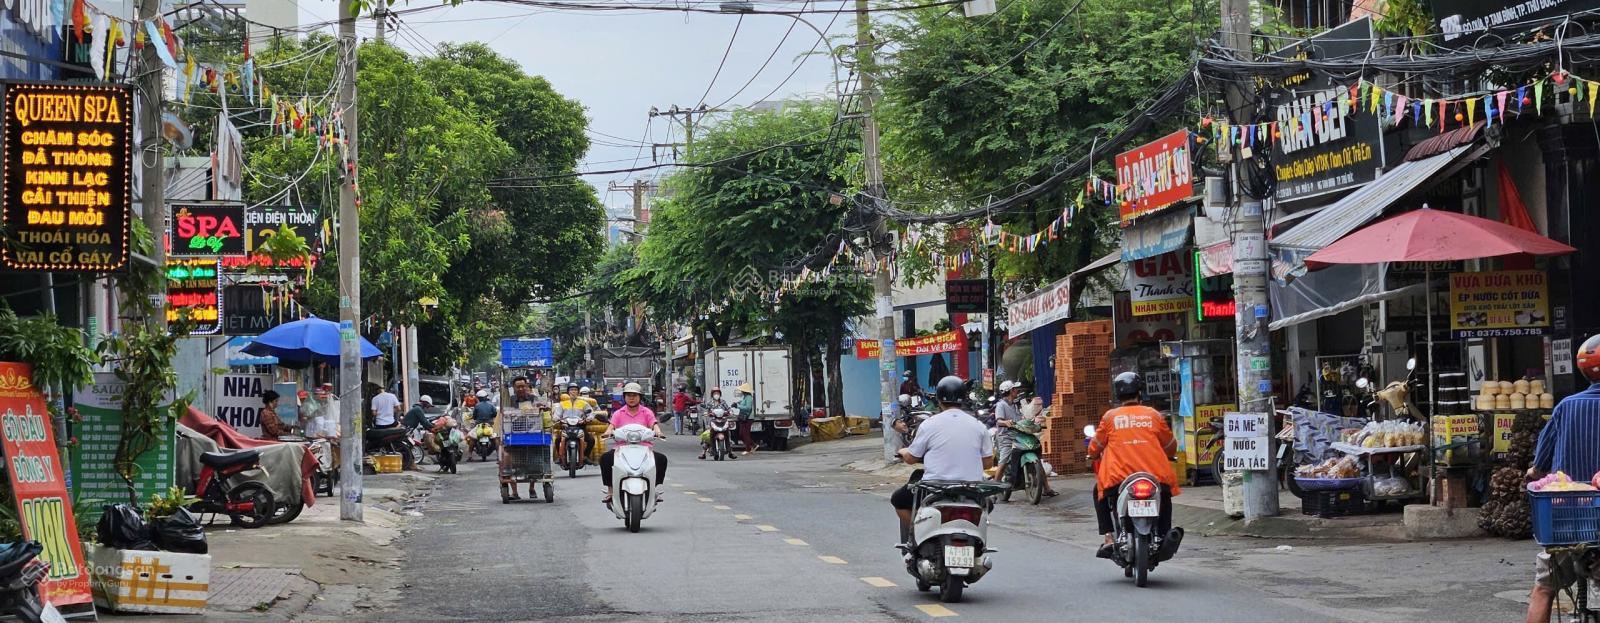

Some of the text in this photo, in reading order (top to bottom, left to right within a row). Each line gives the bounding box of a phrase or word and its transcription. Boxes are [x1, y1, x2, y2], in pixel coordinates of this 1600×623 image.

[15, 94, 122, 126] QUEEN SPA
[21, 128, 113, 146] CHĂM SÓC
[52, 149, 112, 166] THÔNG
[1173, 147, 1189, 187] 99
[26, 170, 108, 187] KINH LẠC
[22, 187, 111, 206] CẢI THIỆN
[28, 208, 104, 225] ĐAU MỎI
[178, 215, 241, 238] SPA
[18, 229, 111, 244] THOÁI HÓA
[16, 246, 112, 263] VAI CỔ GÁY
[224, 377, 262, 397] NHA
[1130, 420, 1152, 428] Food
[1243, 420, 1256, 432] ME
[1233, 438, 1256, 450] NƯỚC
